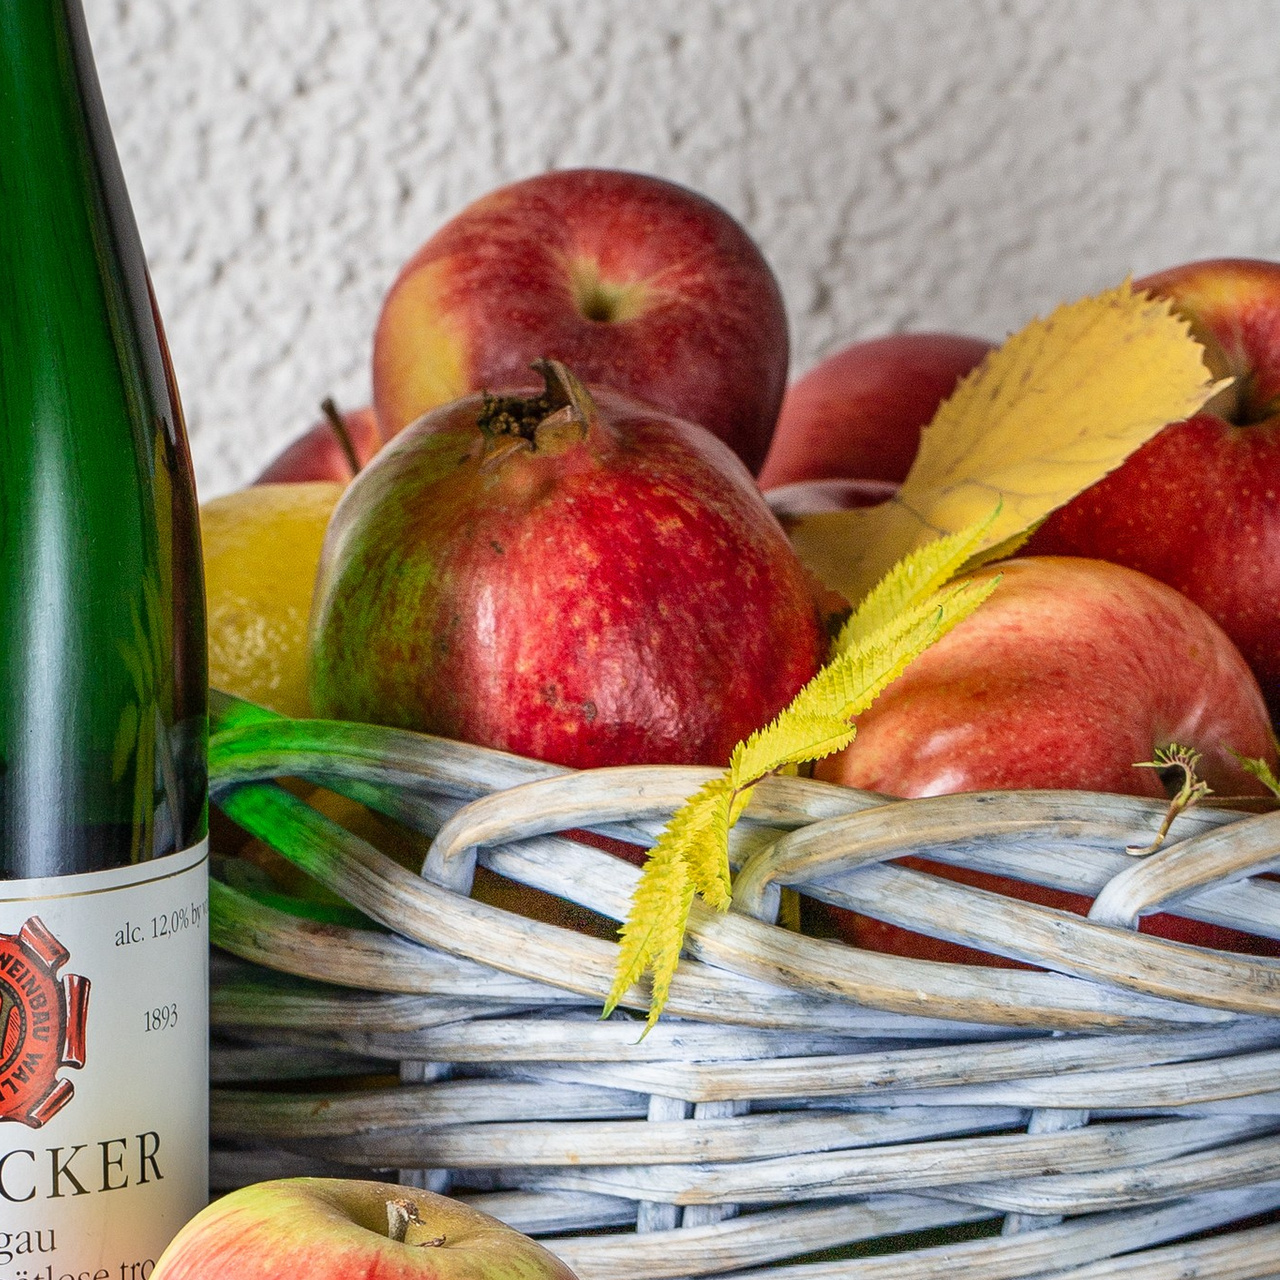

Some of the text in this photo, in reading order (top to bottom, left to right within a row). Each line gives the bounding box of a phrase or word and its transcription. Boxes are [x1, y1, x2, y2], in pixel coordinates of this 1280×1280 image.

[114, 926, 145, 947] alc.
[150, 909, 190, 939] 12,0%
[191, 902, 202, 928] by
[143, 1002, 178, 1033] 1893
